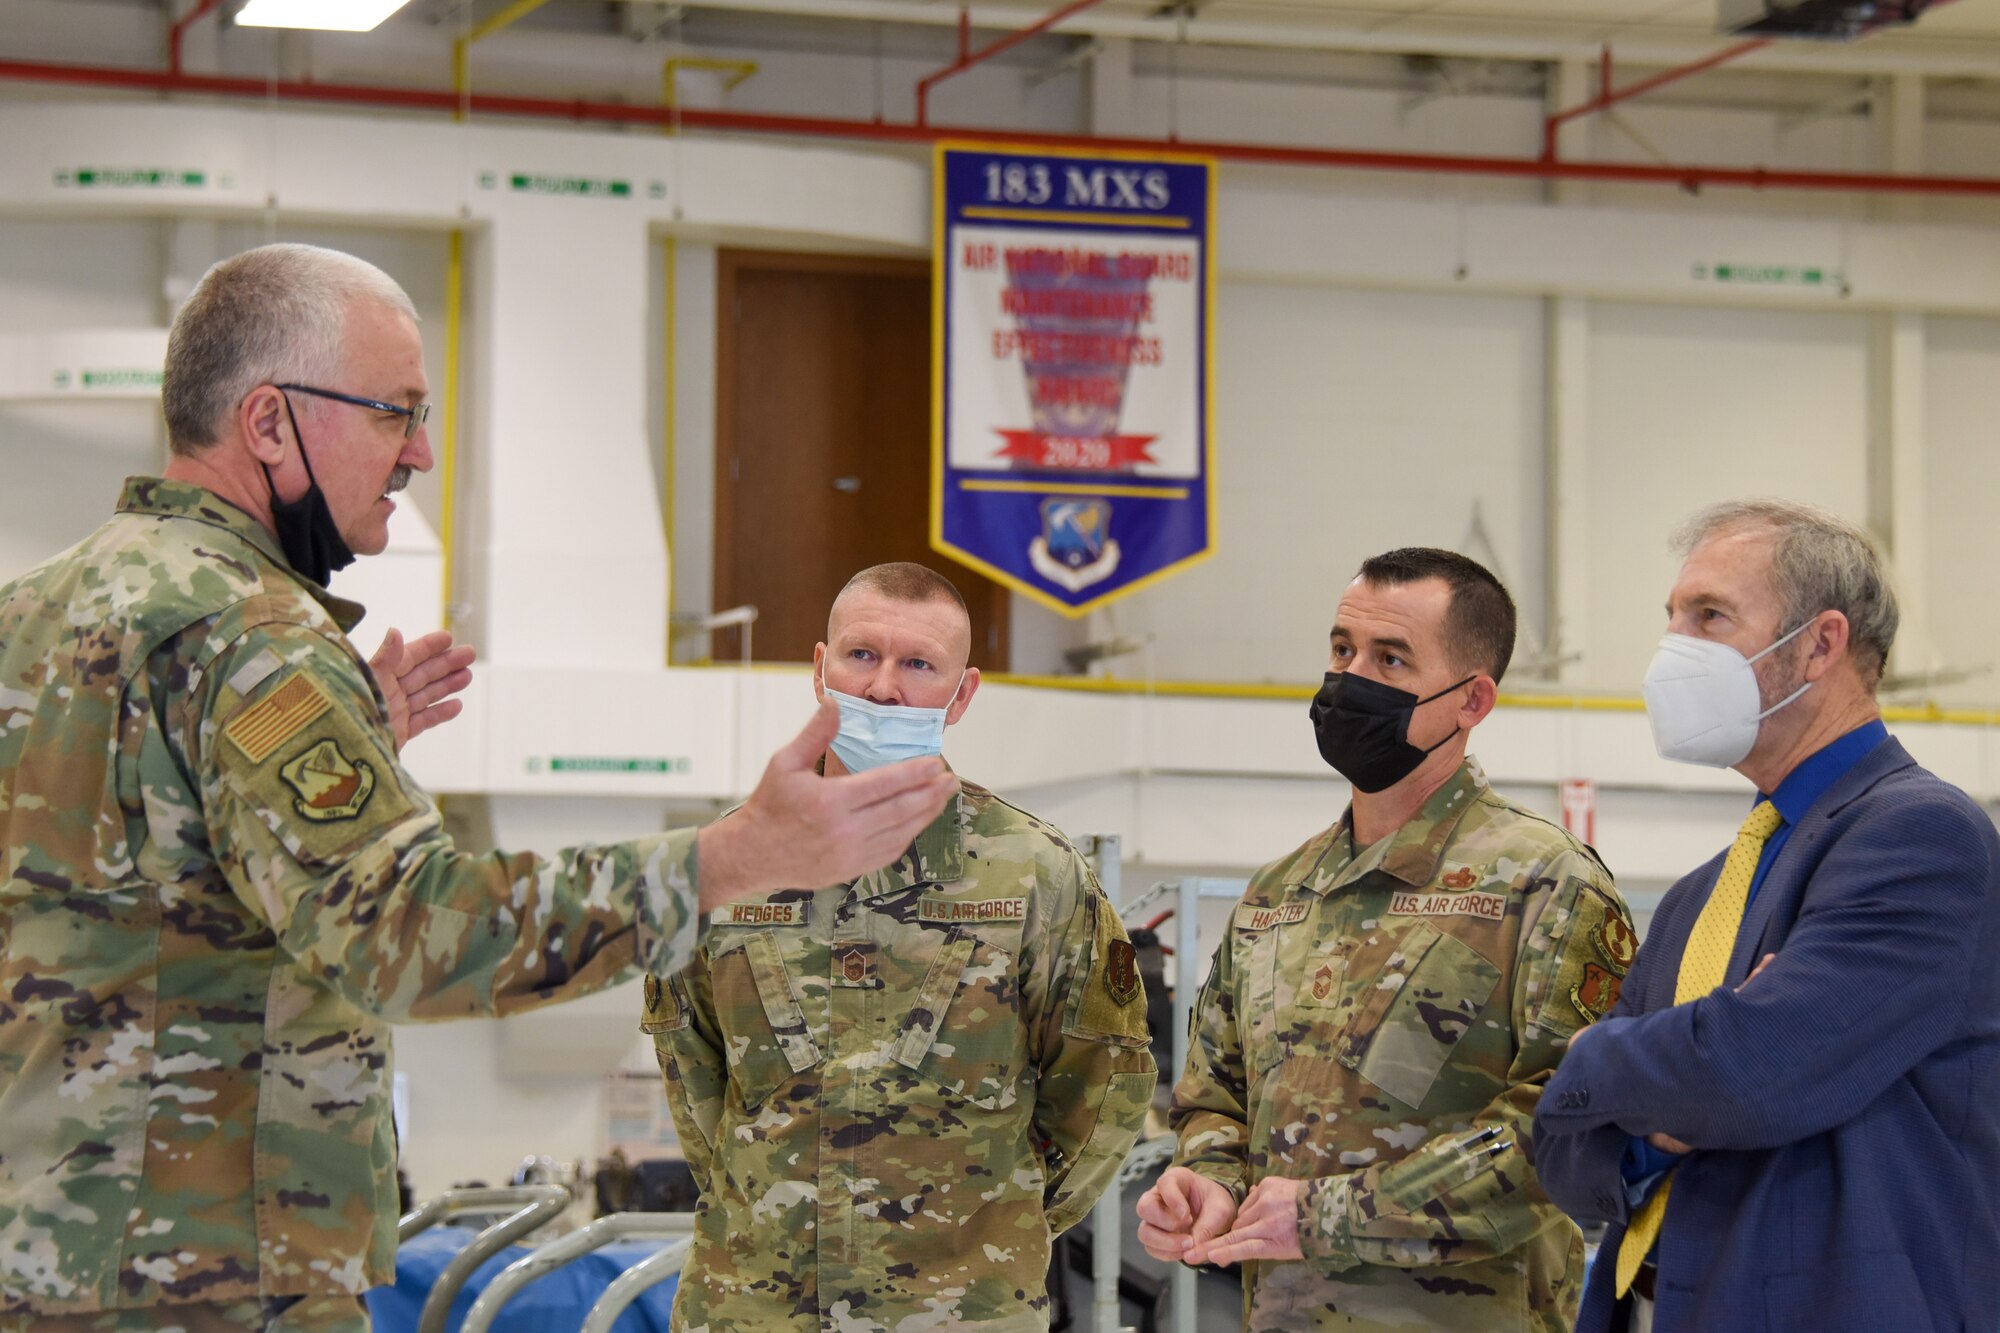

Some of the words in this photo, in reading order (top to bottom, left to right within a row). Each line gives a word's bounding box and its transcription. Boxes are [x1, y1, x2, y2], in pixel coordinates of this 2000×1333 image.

[984, 161, 1052, 204] 183
[1065, 165, 1170, 210] MXS
[963, 244, 994, 268] AIR
[1042, 438, 1111, 468] 2020
[733, 905, 792, 922] HEDGES
[923, 900, 949, 919] U.S.
[951, 903, 975, 919] AIR
[978, 901, 1022, 919] FORCE
[1392, 896, 1418, 913] U.S.
[1421, 897, 1449, 913] AIR
[1451, 896, 1503, 916] FORCE
